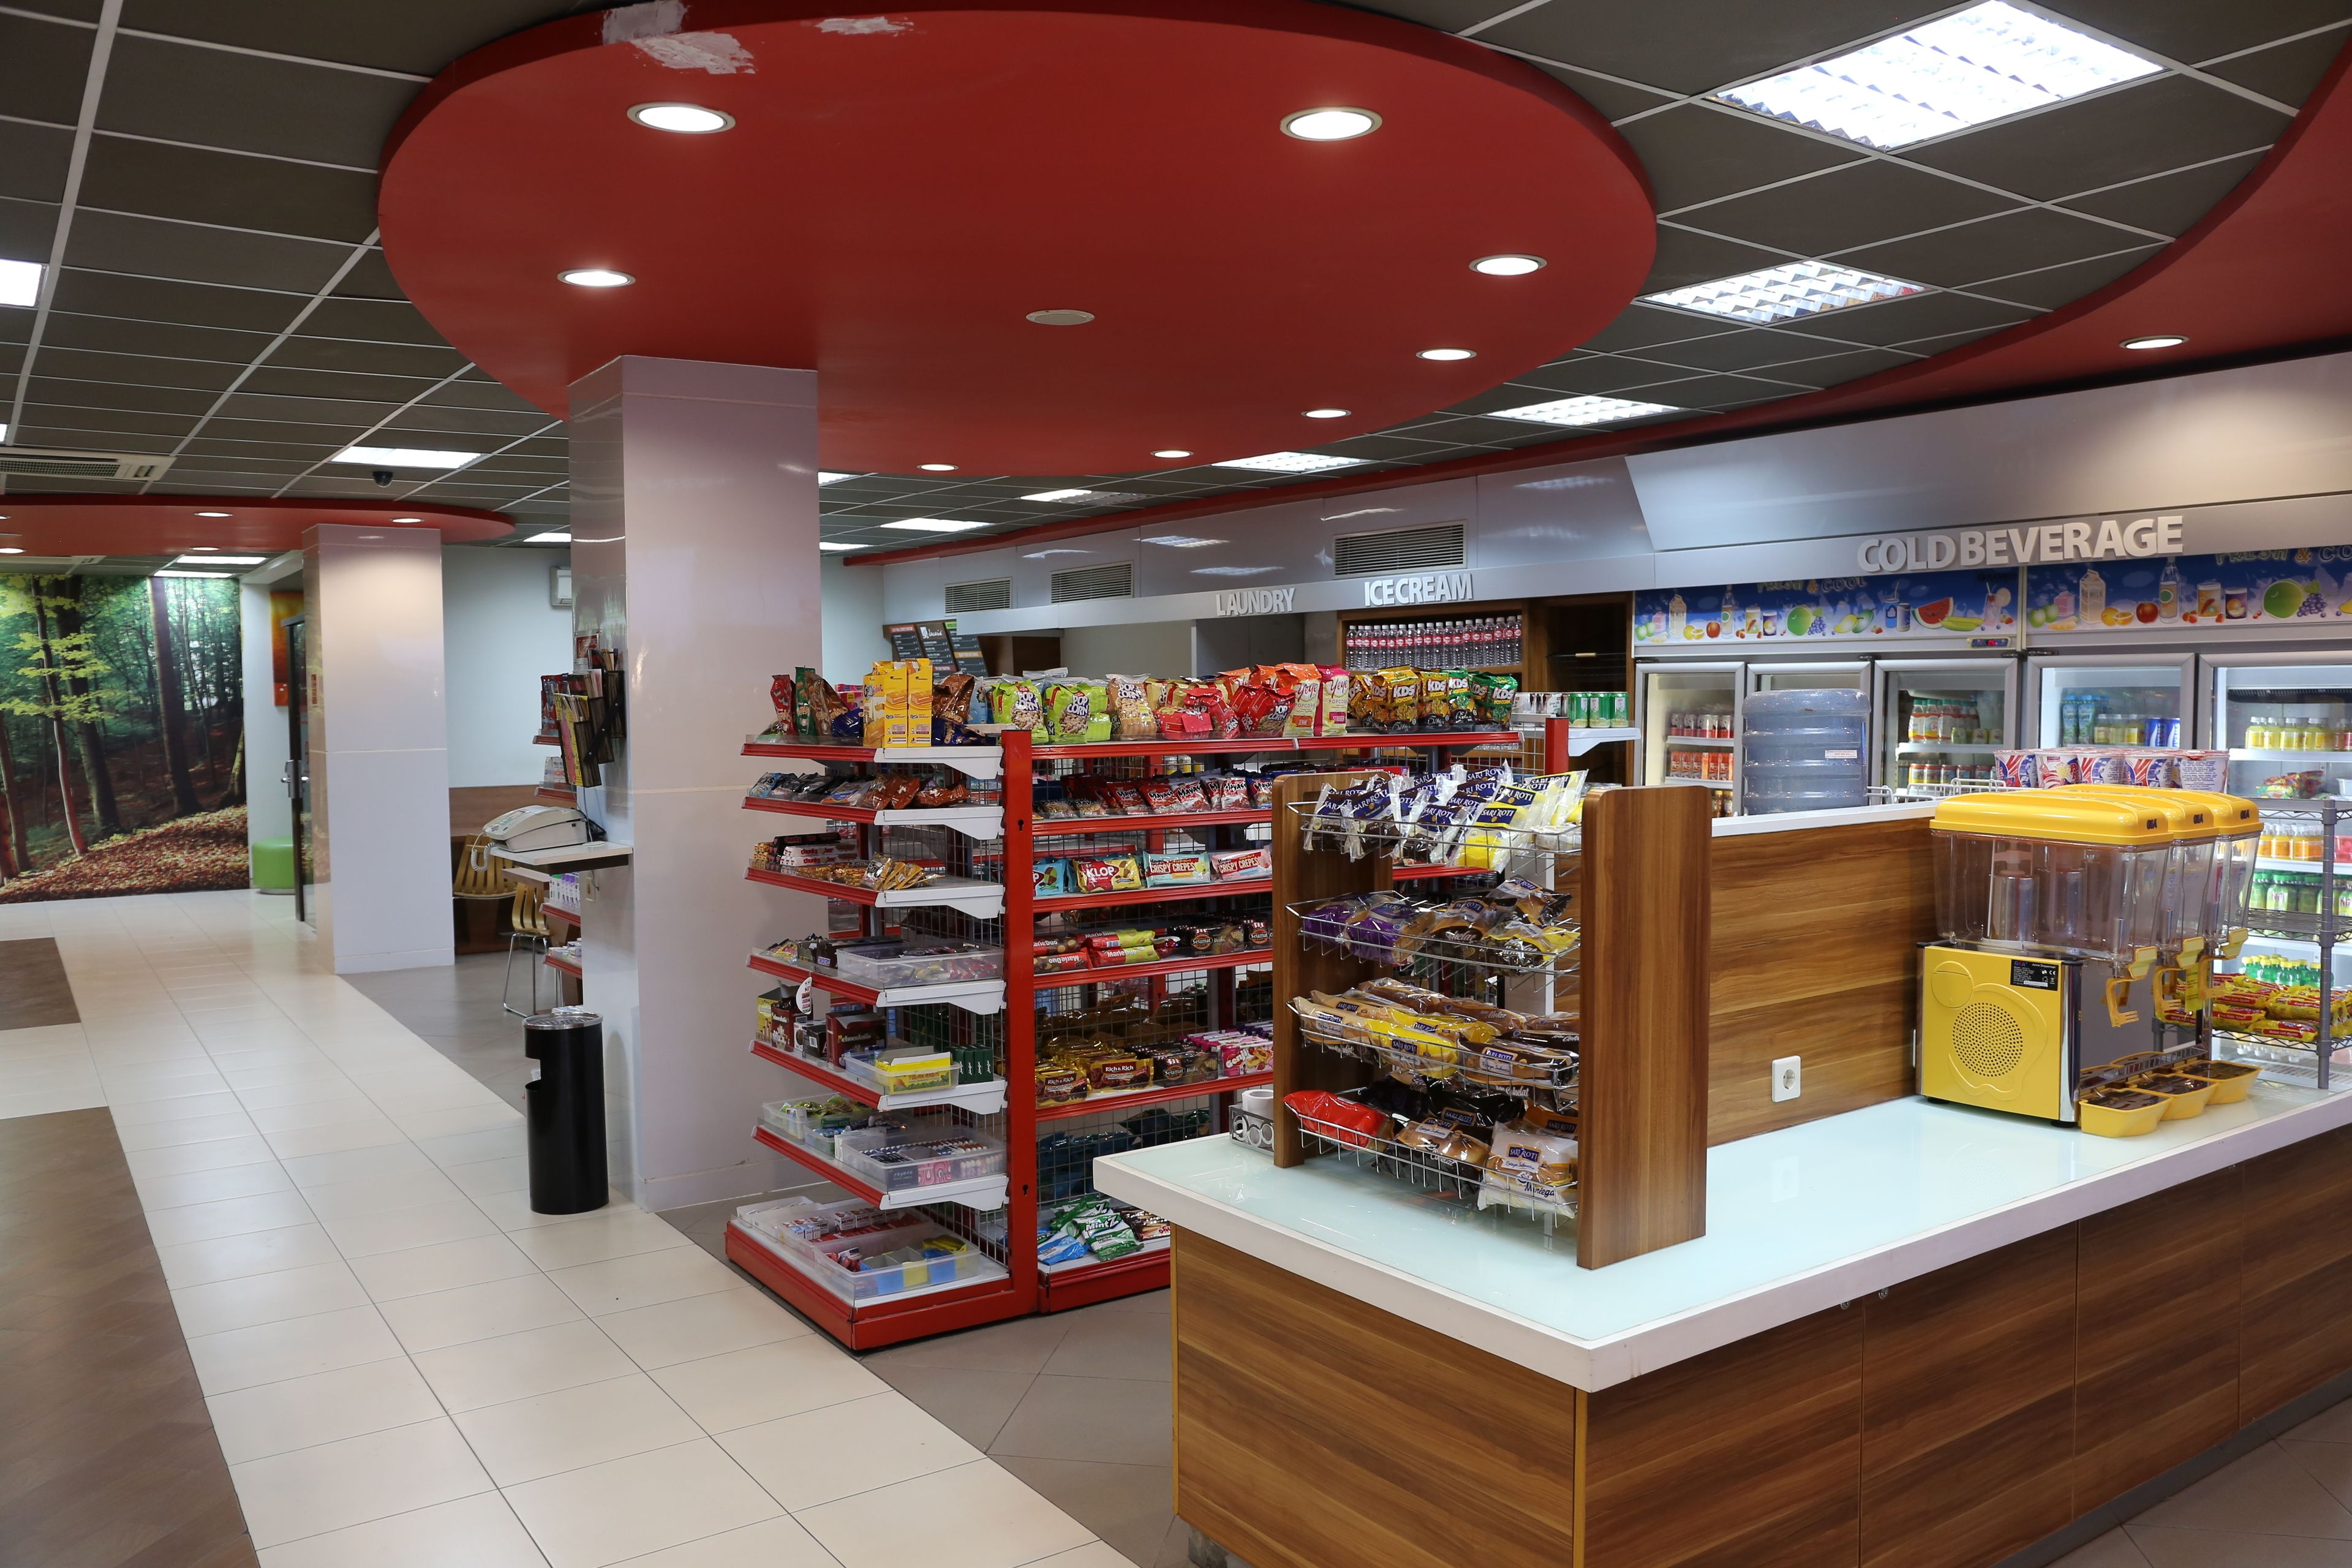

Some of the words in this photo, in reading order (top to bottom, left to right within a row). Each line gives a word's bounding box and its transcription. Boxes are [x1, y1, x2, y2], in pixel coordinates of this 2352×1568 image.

[1857, 535, 1956, 572] COLD
[1960, 514, 2183, 566] BEVERAGE
[1822, 576, 1867, 592] COOL
[1215, 588, 1296, 617] LAUNDRY
[1118, 683, 1135, 692] POP
[1427, 680, 1446, 692] KDS
[1449, 678, 1468, 688] KDS
[1117, 690, 1143, 699] CORN
[1393, 684, 1416, 698] KDS
[1492, 688, 1515, 700] KDS
[1017, 692, 1035, 703] POP
[1072, 695, 1088, 705] POP
[1015, 699, 1039, 712] CORN
[1066, 703, 1089, 716] CORN
[1275, 705, 1288, 714] POP
[1267, 711, 1288, 722] CORN
[1415, 777, 1430, 786] SARI
[1467, 771, 1483, 781] SARI
[1526, 782, 1547, 791] ROTI
[1354, 800, 1367, 810] SARI
[1370, 790, 1389, 803] ROTI
[1449, 796, 1462, 805] SARI
[1515, 791, 1533, 801] ROTI
[1423, 807, 1436, 815] SARI
[1438, 809, 1454, 818] ROTI
[1481, 809, 1496, 817] SARI
[1498, 809, 1514, 817] ROTI
[1150, 863, 1171, 874] CRISPY
[1172, 862, 1195, 872] CREPES
[1219, 862, 1238, 873] CRISPY
[1238, 857, 1259, 869] CREPES
[1521, 880, 1536, 889] ROTI
[1107, 949, 1137, 958] MarieDuo
[1048, 955, 1080, 964] MarieDuo
[1404, 1042, 1417, 1054] ROTI
[1548, 1121, 1559, 1129] SARI
[1509, 1148, 1521, 1156] SARI
[1521, 1150, 1539, 1160] ROTI
[1085, 1215, 1120, 1232] MintZ
